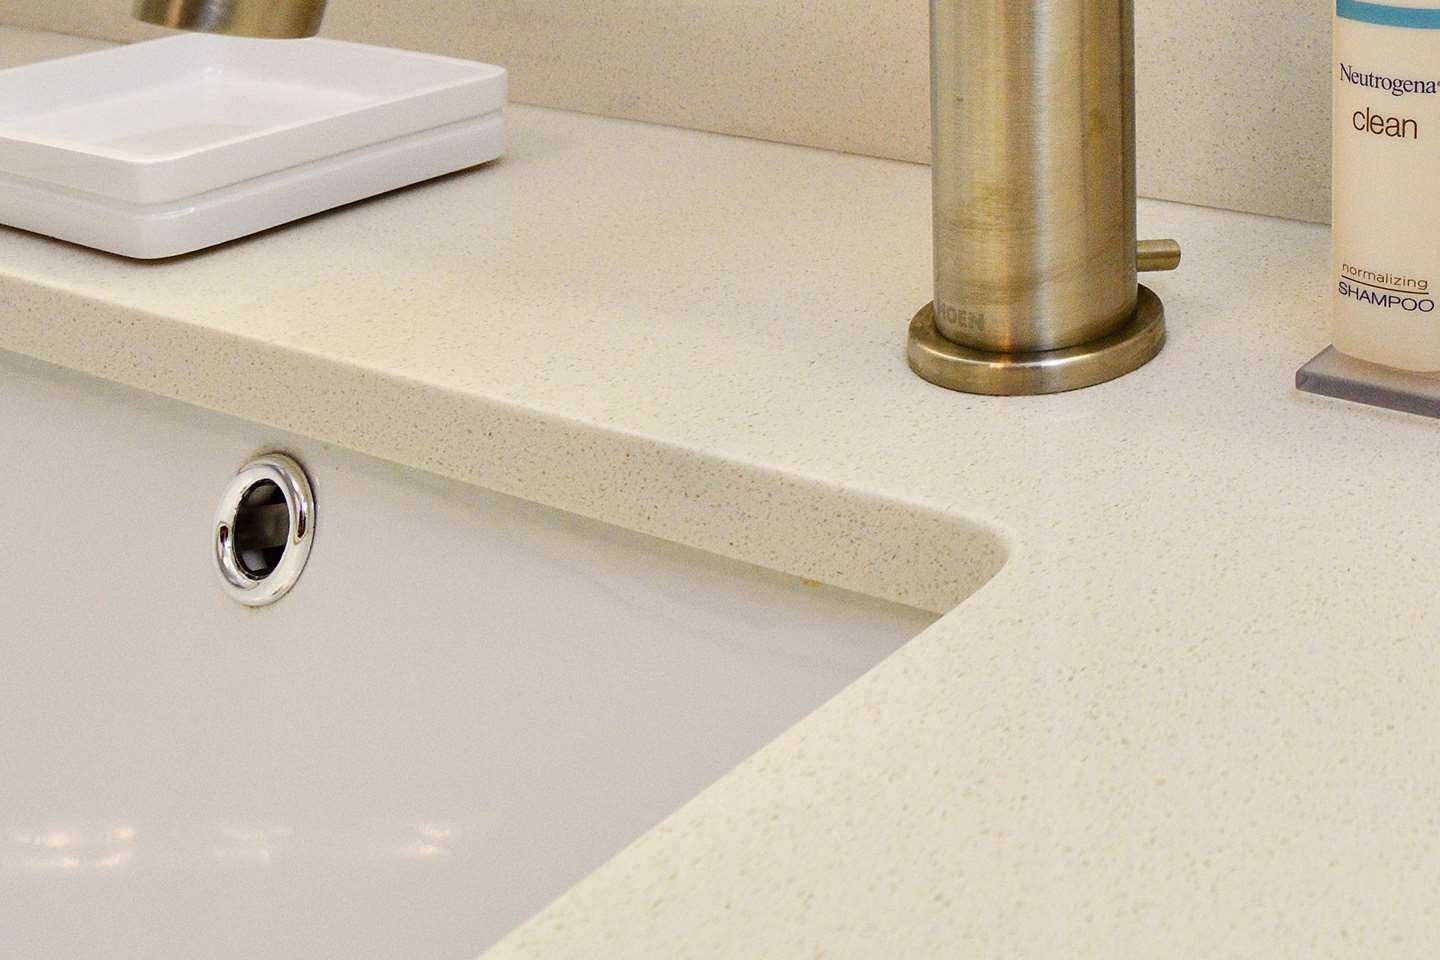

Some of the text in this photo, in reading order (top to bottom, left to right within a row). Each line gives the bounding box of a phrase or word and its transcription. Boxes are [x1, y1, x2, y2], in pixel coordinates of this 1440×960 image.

[1352, 106, 1418, 140] clean
[1341, 263, 1429, 290] normalizing
[1338, 280, 1435, 313] SHAMPOO
